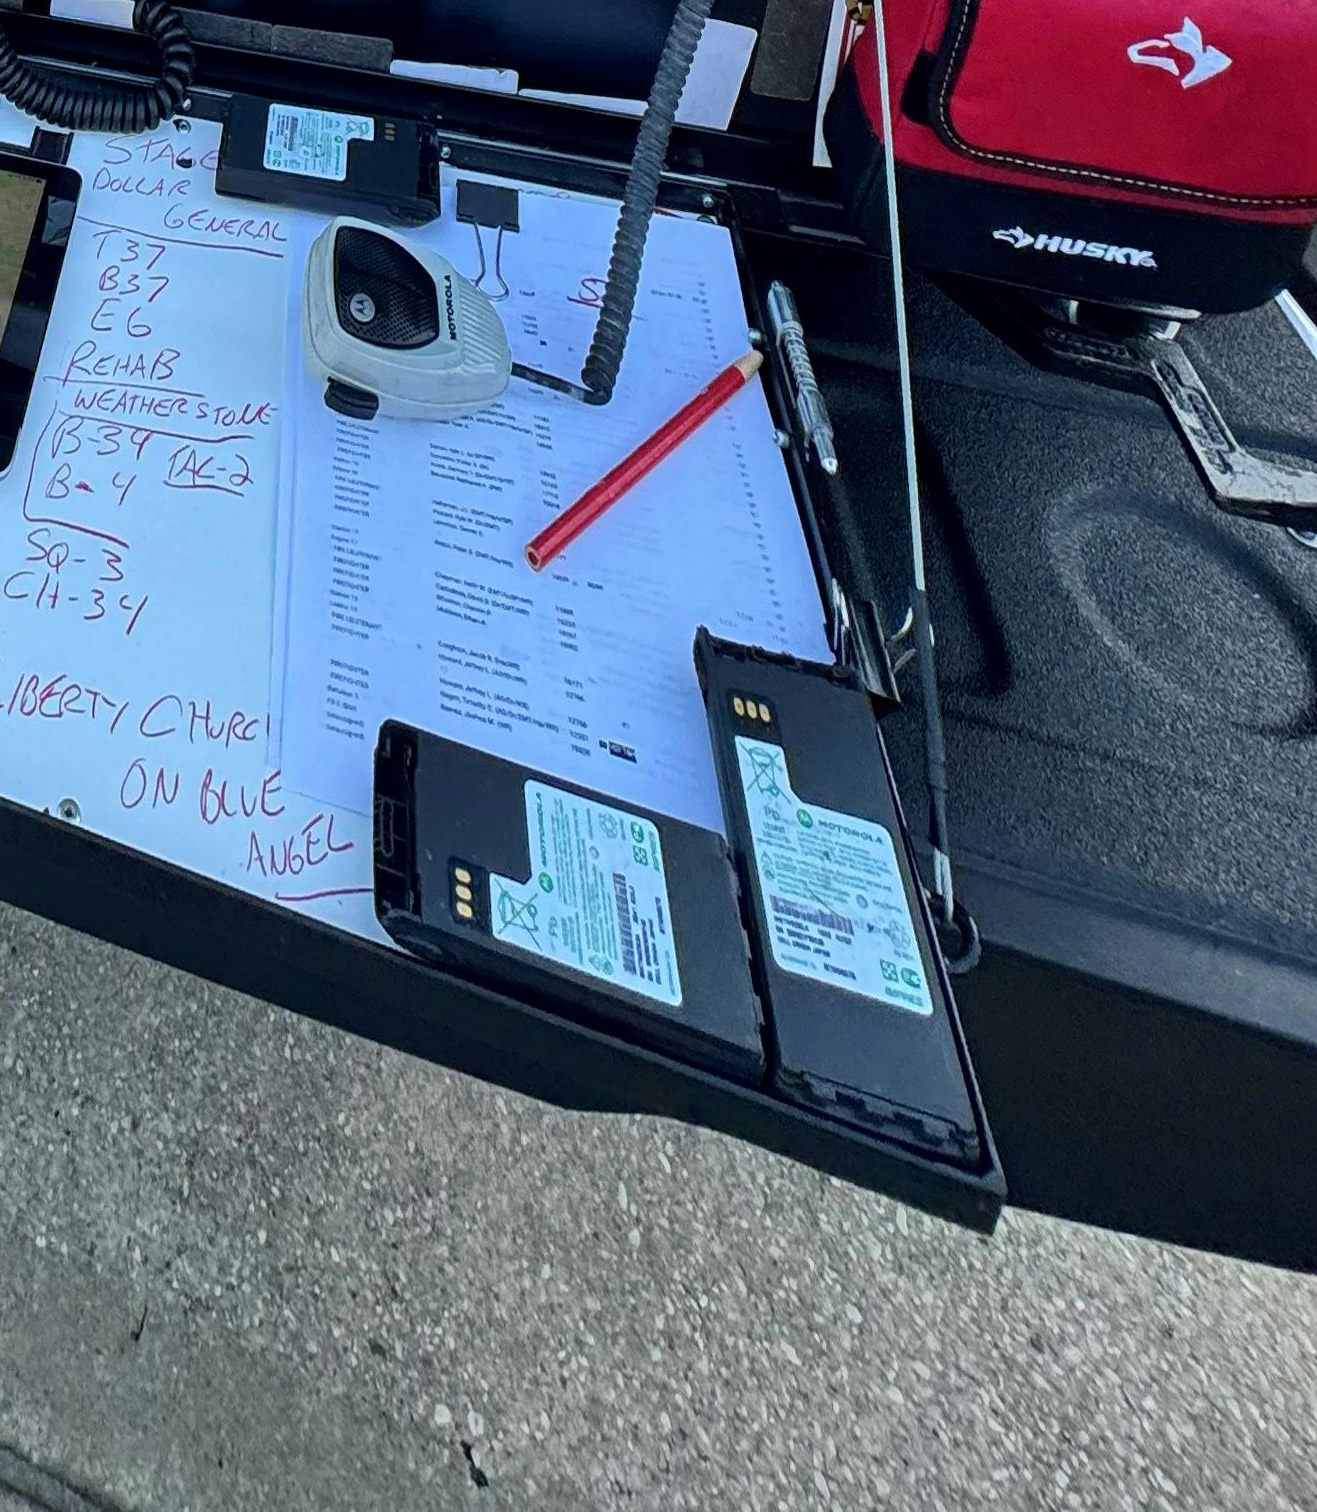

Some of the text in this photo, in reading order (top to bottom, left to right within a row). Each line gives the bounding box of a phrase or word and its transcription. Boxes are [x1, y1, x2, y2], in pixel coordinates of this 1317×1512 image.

[92, 167, 191, 197] DOLLAR
[163, 202, 289, 243] GENERAL
[1032, 233, 1154, 267] HUSKY
[444, 274, 457, 341] MOTOROLA
[62, 340, 181, 383] REHAB
[119, 758, 286, 825] ON BLUE
[245, 812, 355, 879] ANGEL
[817, 818, 886, 846] MOTOROLA
